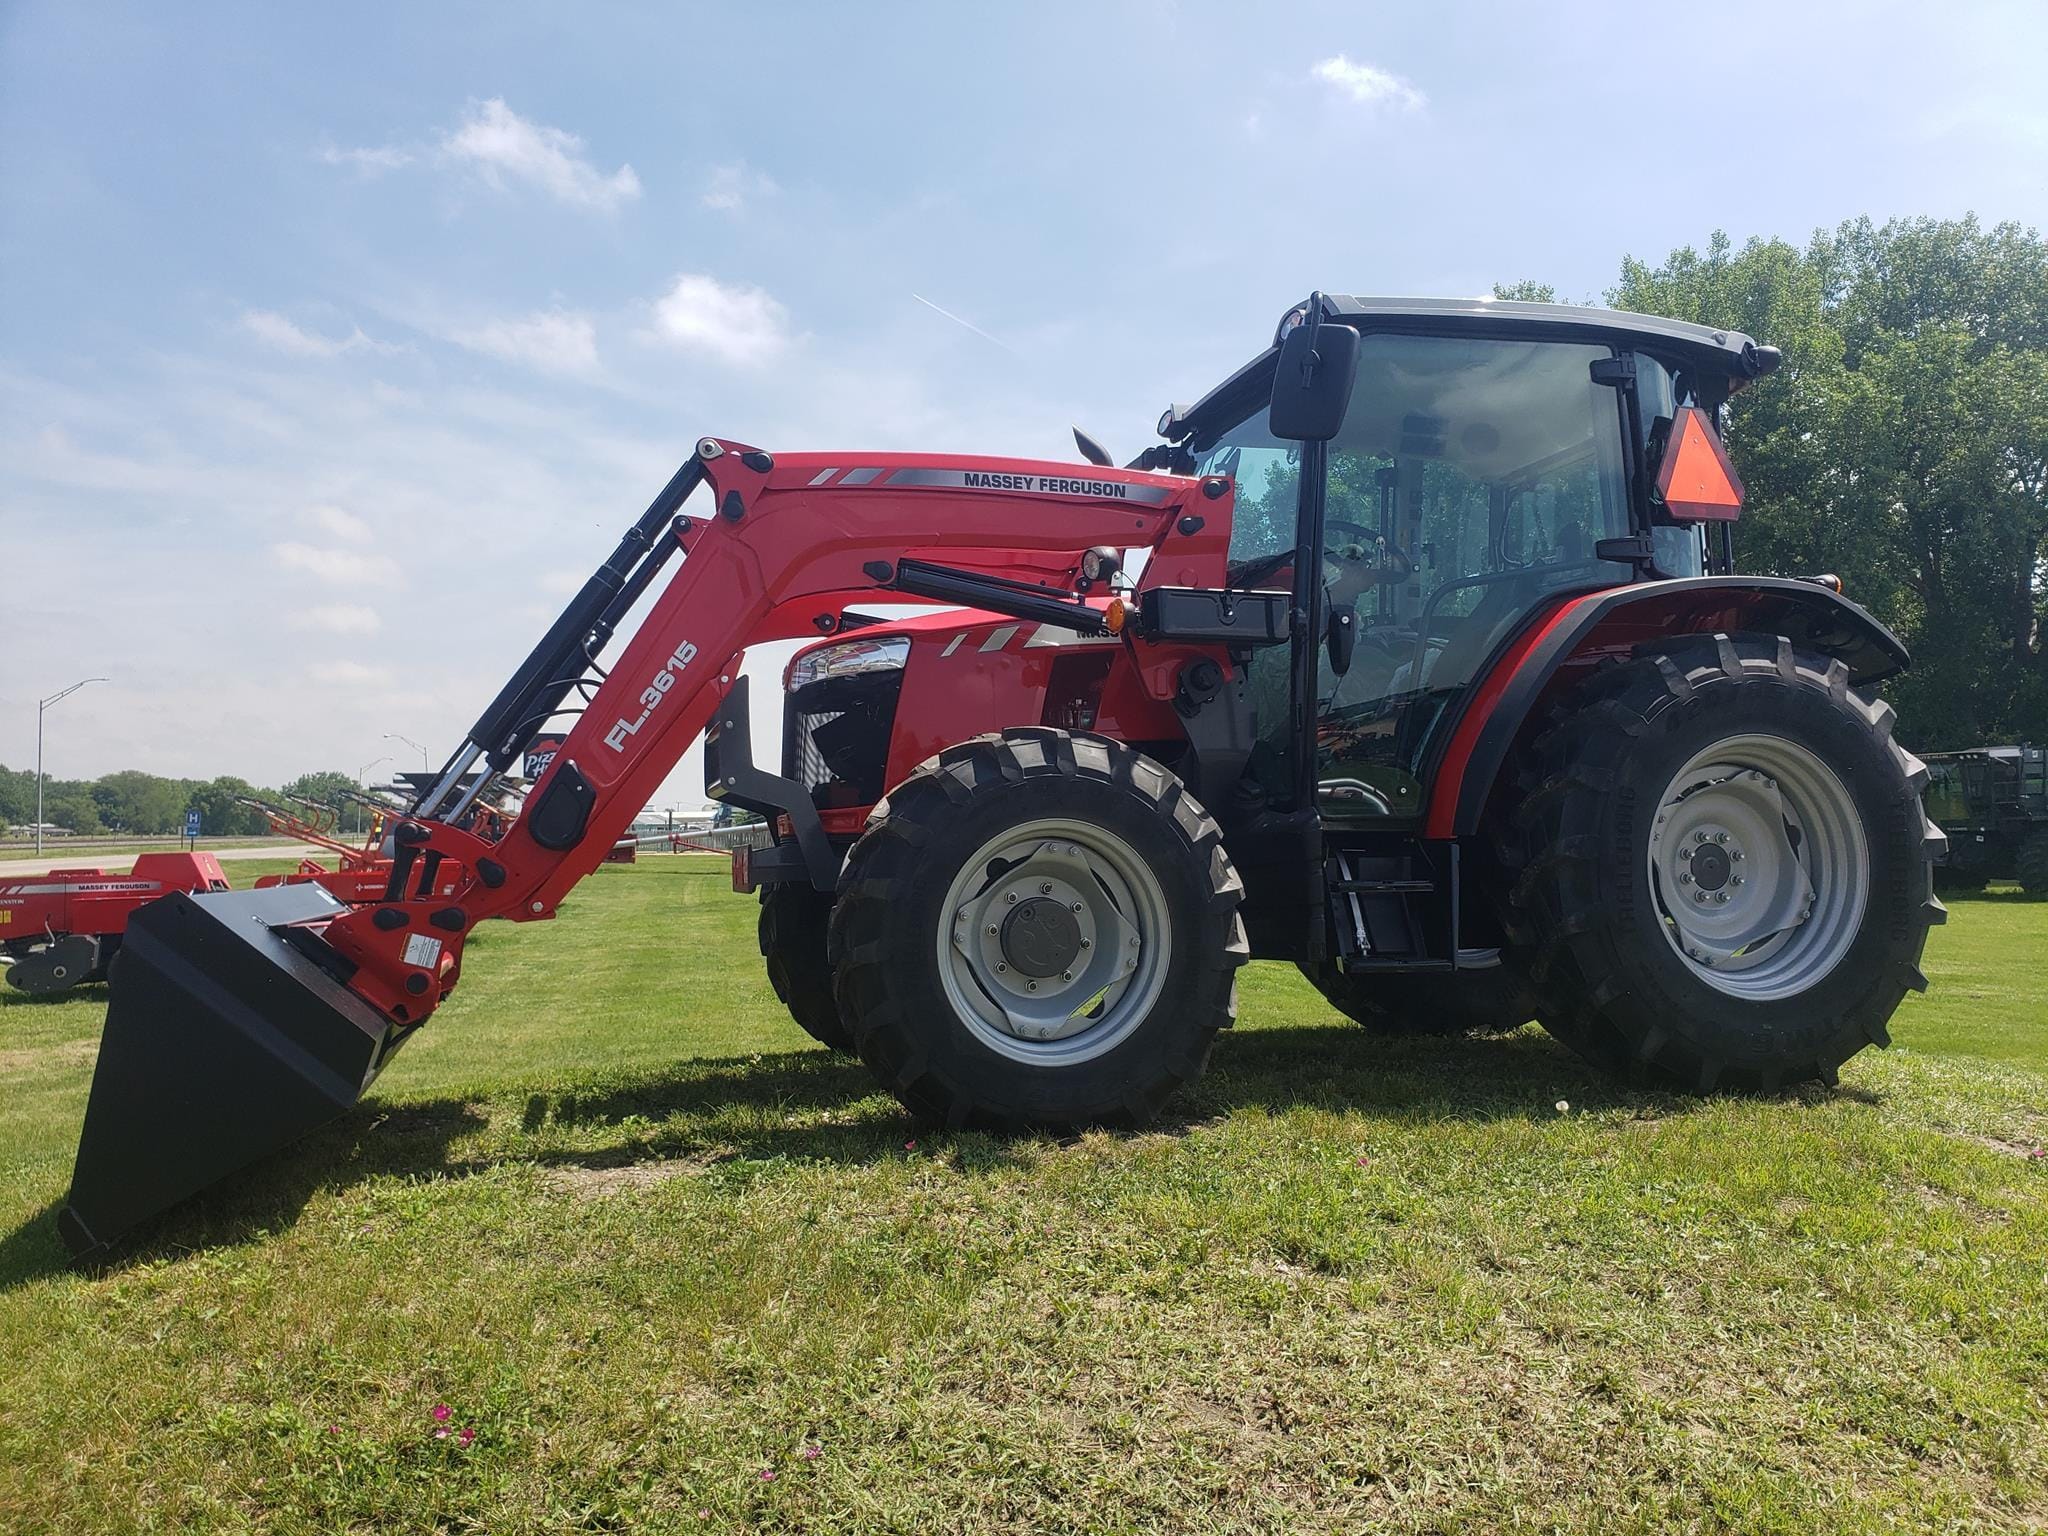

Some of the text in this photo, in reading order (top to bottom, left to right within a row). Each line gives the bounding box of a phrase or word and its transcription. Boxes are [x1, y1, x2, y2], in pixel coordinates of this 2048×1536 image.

[964, 472, 1127, 498] MASSEY FERGUSON
[603, 639, 698, 753] FL.3615
[525, 751, 558, 773] Pizz
[189, 813, 198, 823] H
